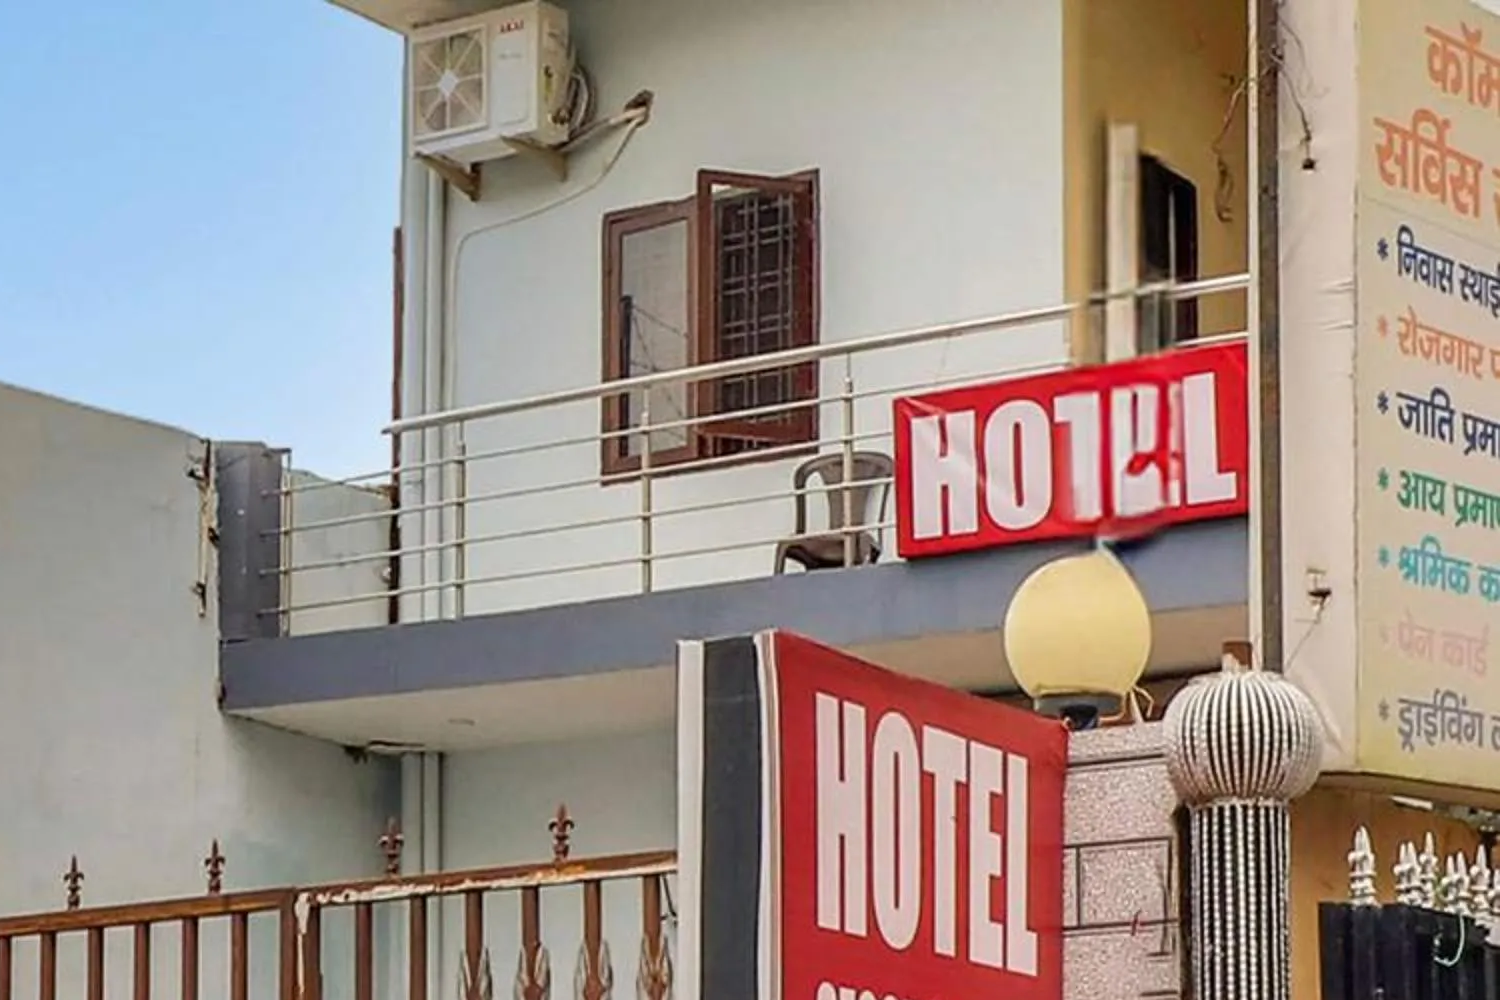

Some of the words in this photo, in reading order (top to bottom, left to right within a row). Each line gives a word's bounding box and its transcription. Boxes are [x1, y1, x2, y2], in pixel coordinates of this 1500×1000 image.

[1373, 107, 1484, 219] सर्विस
[1396, 224, 1454, 294] निवास
[1396, 305, 1485, 379] रोजगार
[1396, 387, 1455, 443] जाति
[1397, 470, 1446, 516] आय
[1398, 534, 1473, 596] श्रमिक
[815, 692, 1038, 977] HOTEL
